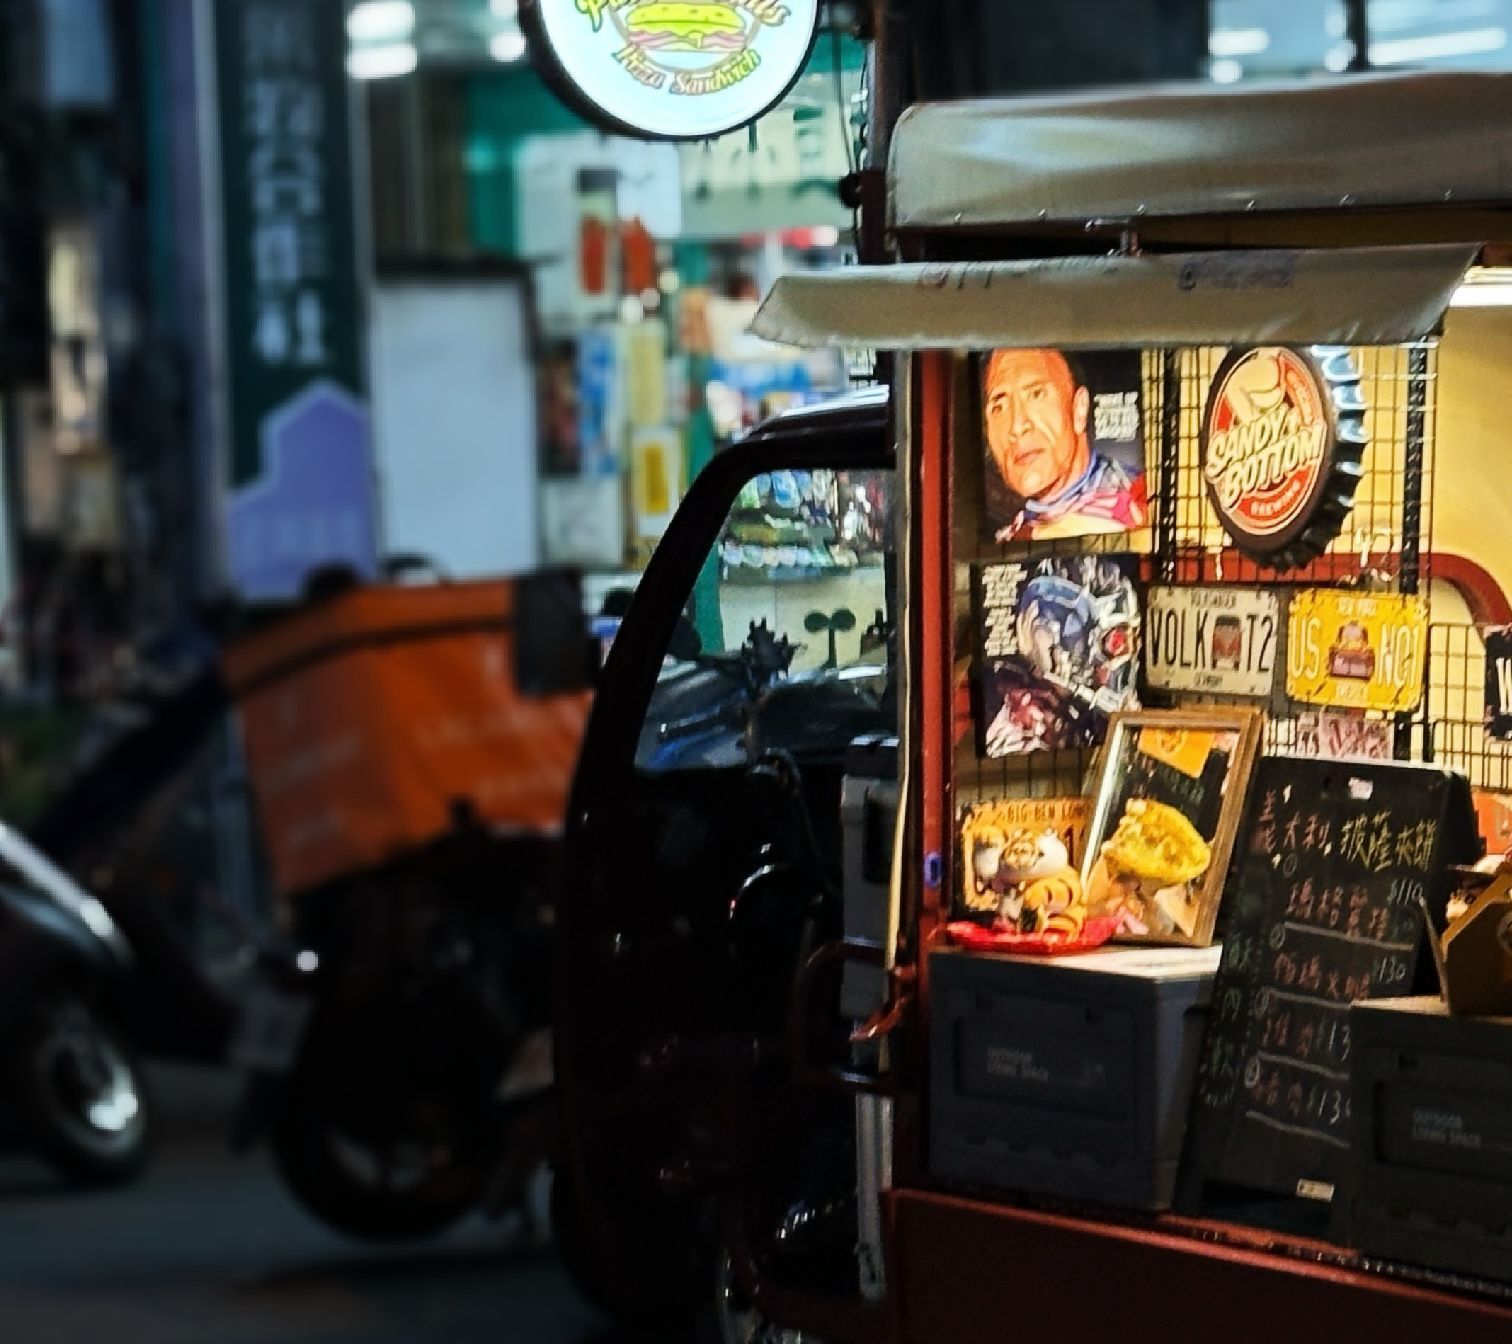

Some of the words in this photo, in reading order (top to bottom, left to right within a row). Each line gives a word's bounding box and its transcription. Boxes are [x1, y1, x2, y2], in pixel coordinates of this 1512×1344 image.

[670, 47, 761, 95] Sandwich
[1223, 421, 1325, 510] BOTTOM
[1149, 608, 1207, 670] VOLK
[1246, 614, 1274, 673] T2
[1289, 616, 1321, 681] US
